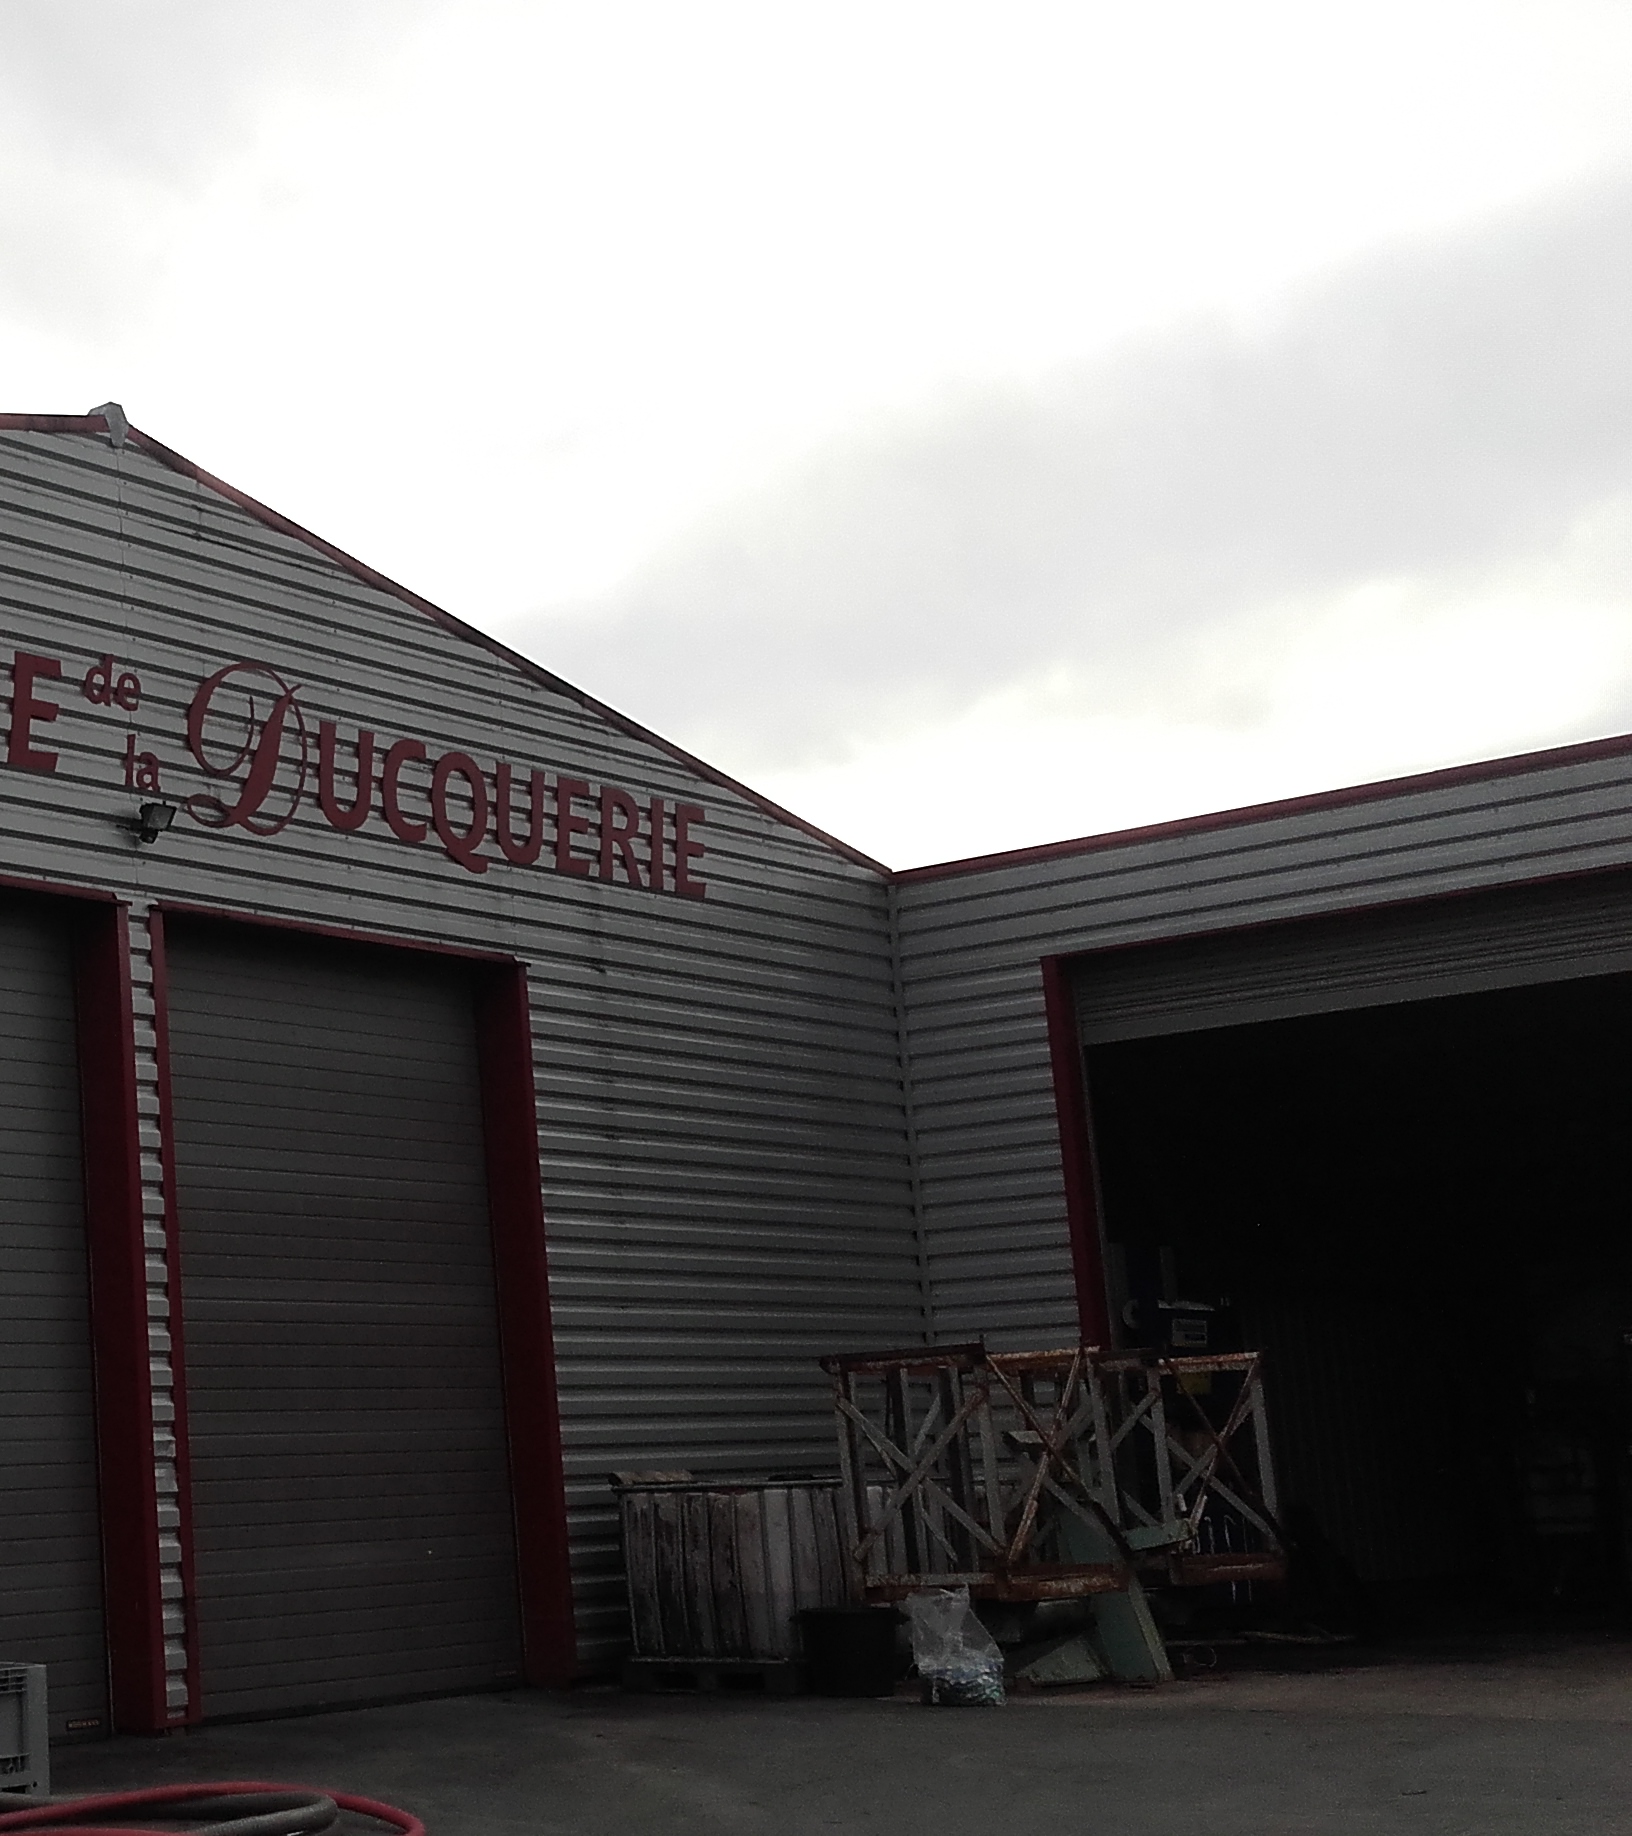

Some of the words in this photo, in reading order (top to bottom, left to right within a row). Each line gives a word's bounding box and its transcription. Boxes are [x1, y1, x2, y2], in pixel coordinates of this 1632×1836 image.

[83, 654, 142, 712] de
[124, 733, 161, 791] la
[185, 661, 707, 898] DUCQUERIE
